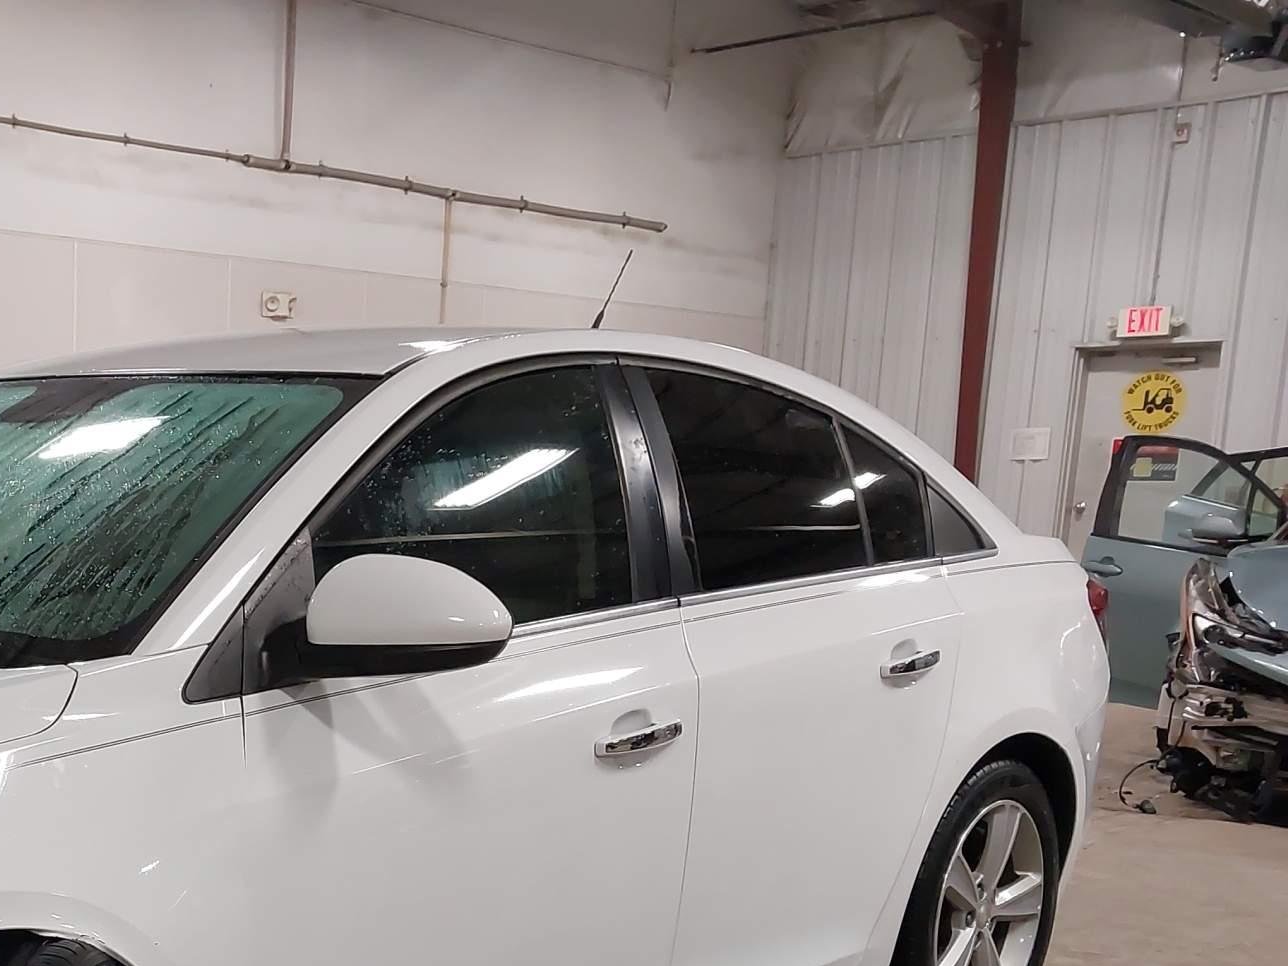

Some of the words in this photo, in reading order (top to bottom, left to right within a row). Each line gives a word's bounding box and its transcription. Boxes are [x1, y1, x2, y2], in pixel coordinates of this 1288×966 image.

[1127, 307, 1164, 334] EXIT
[1127, 374, 1152, 395] WATCH
[1154, 373, 1171, 382] OUT
[1169, 379, 1183, 395] FOR
[1136, 423, 1153, 431] LIFT
